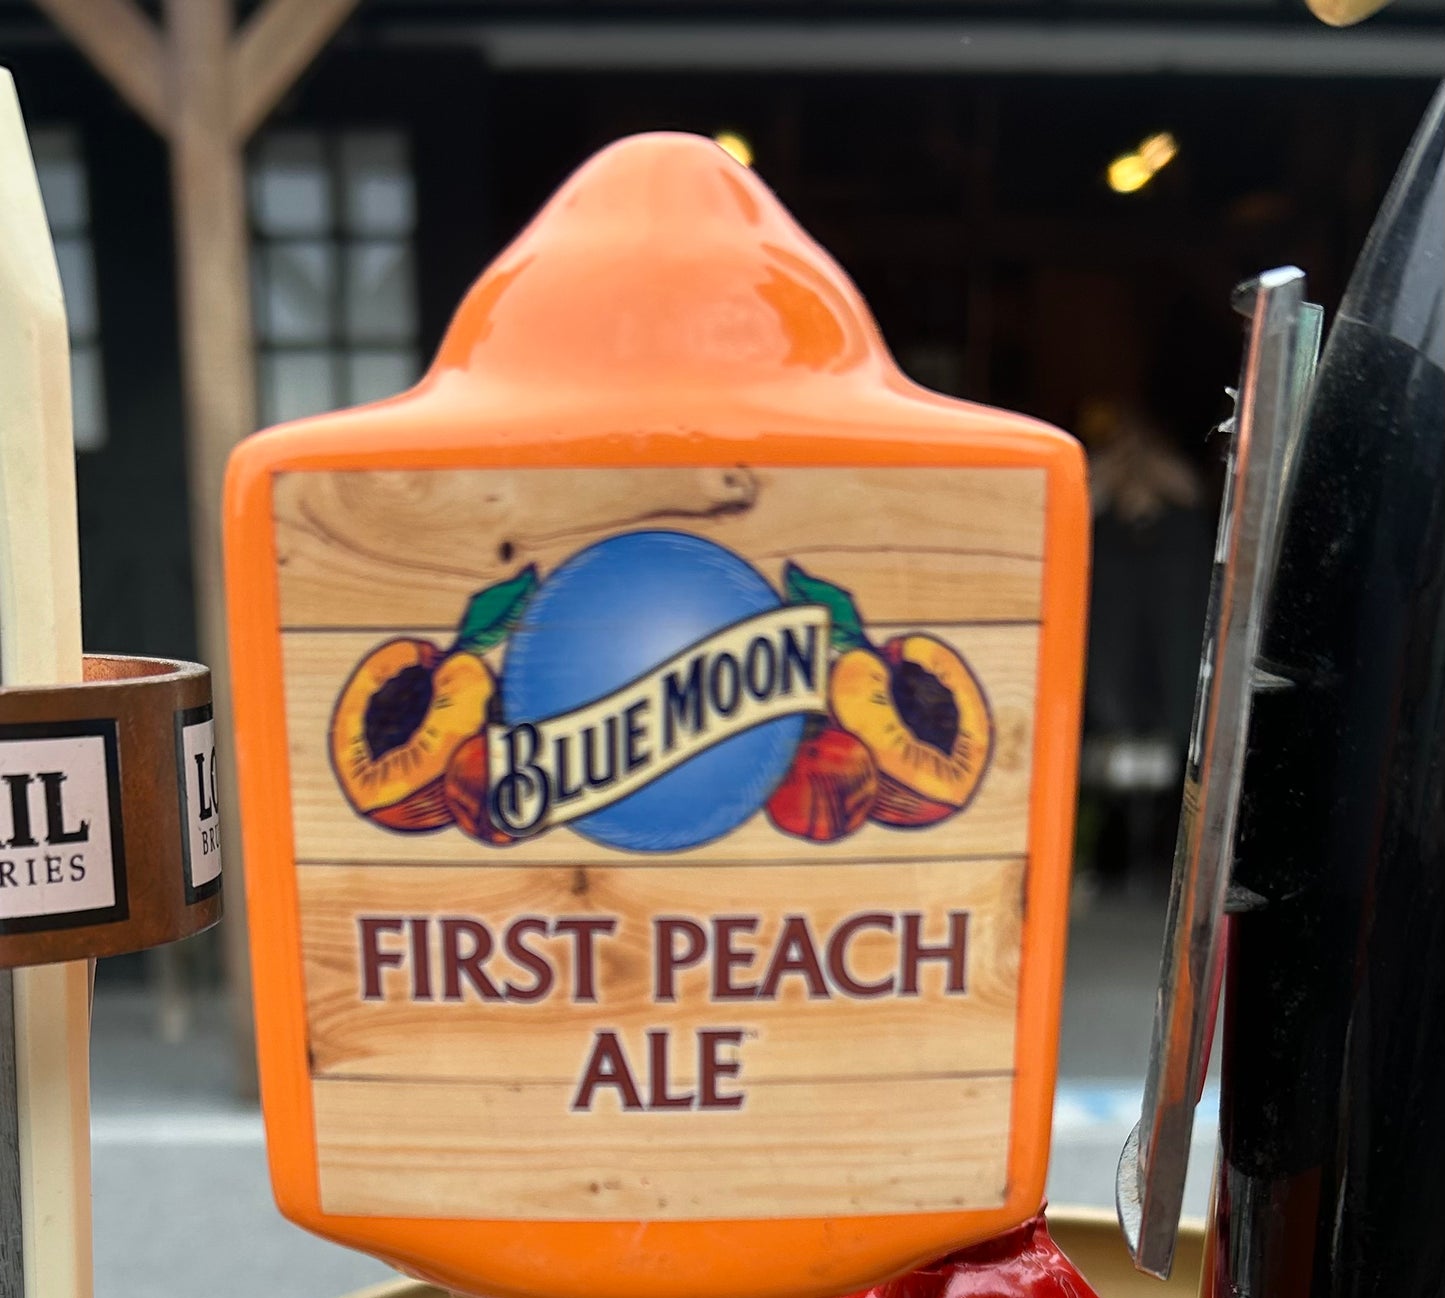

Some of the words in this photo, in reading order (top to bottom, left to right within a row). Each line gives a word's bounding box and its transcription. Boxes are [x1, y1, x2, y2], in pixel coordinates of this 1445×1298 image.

[491, 699, 650, 838] BLUE
[661, 626, 819, 752] MOON
[0, 771, 89, 849] IL
[357, 917, 616, 1001] FIRST
[655, 912, 969, 1001] PEACH
[571, 1029, 745, 1111] ALE
